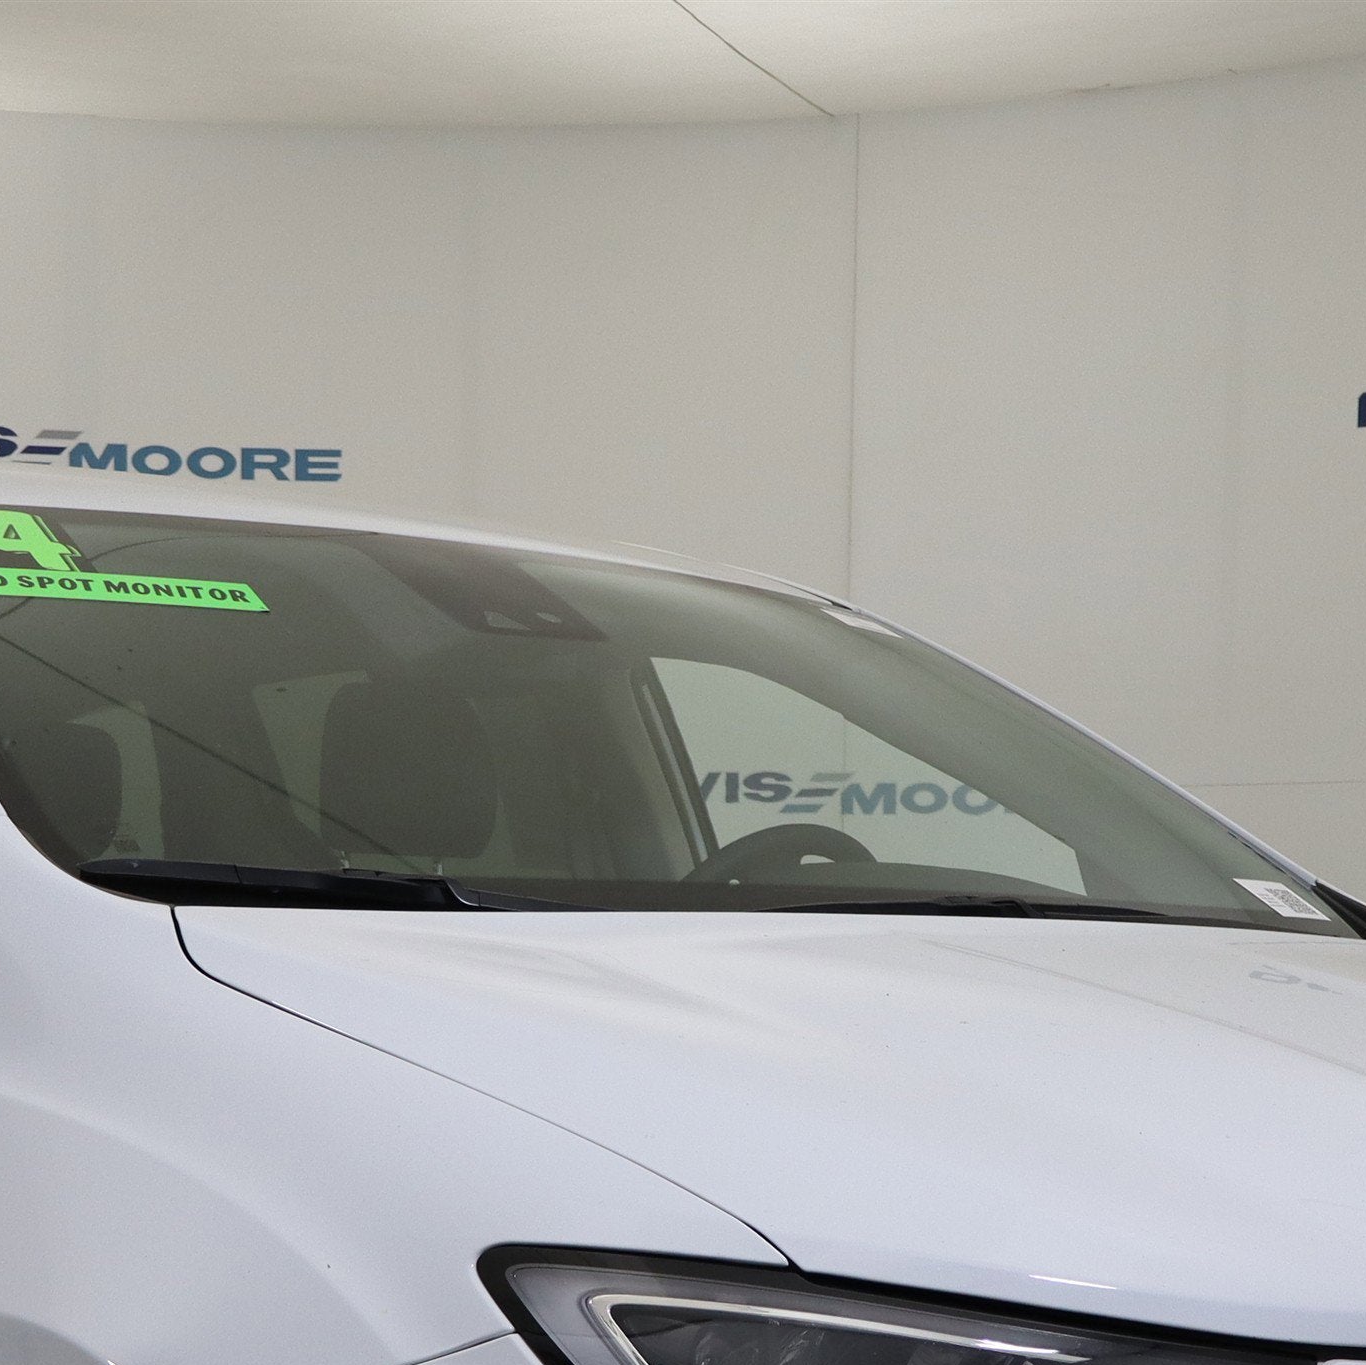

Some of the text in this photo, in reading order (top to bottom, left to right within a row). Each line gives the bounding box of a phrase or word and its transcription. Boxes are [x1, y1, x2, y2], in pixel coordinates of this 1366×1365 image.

[69, 442, 343, 483] MOORE
[17, 575, 94, 592] SPOT
[105, 581, 252, 603] MONITOR
[839, 783, 1012, 816] MOO
